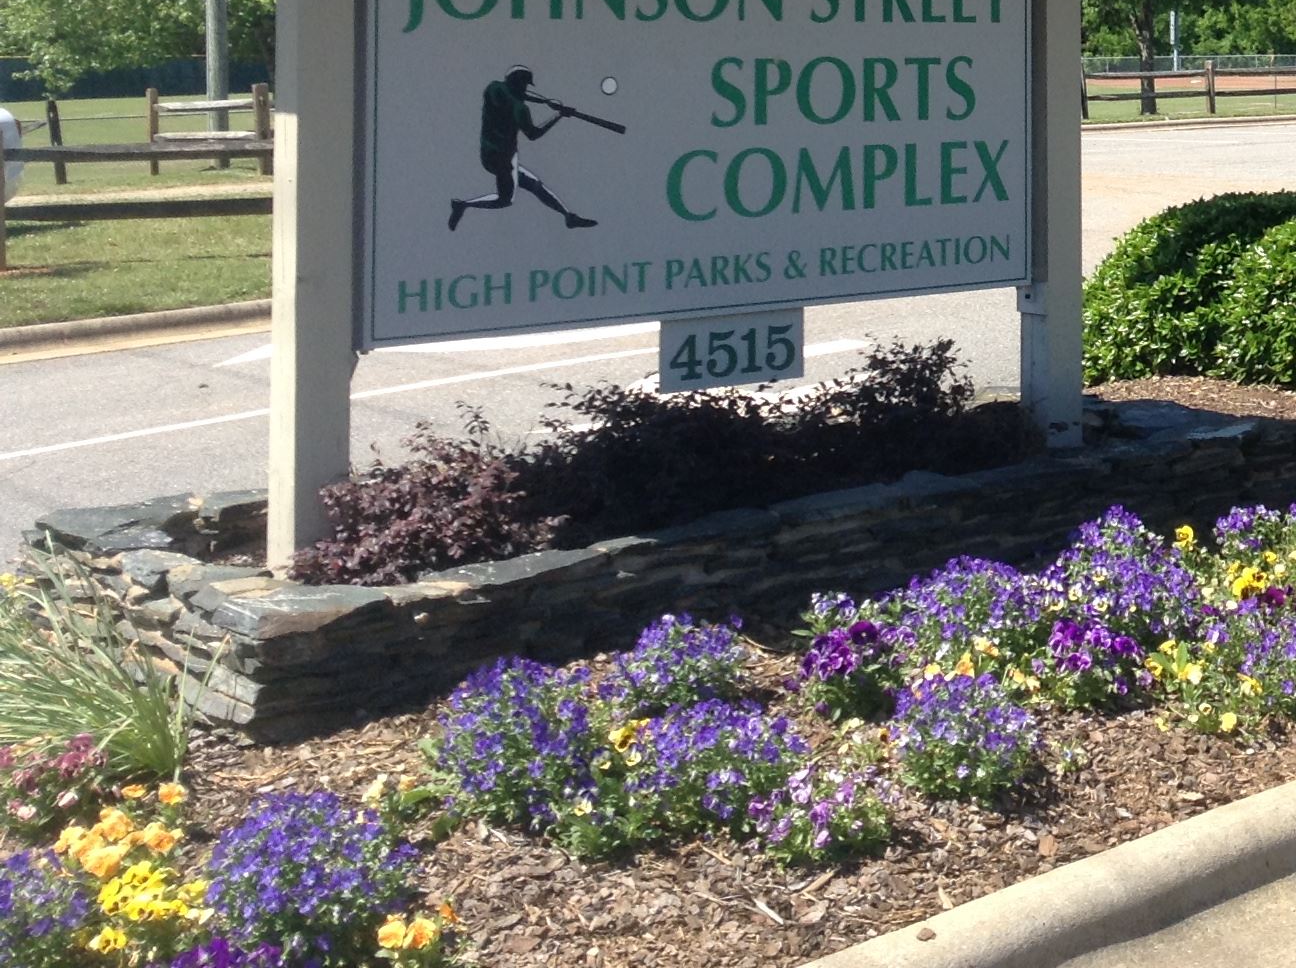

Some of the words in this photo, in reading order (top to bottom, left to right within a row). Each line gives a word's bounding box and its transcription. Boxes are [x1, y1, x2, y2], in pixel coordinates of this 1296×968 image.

[710, 55, 976, 128] SPORTS
[667, 139, 1010, 222] COMPLEX
[399, 272, 512, 314] HIGH
[528, 262, 651, 302] POINT
[665, 251, 772, 290] PARKS
[784, 250, 808, 280] &
[820, 234, 1011, 276] RECREATION
[669, 324, 796, 381] 4515
